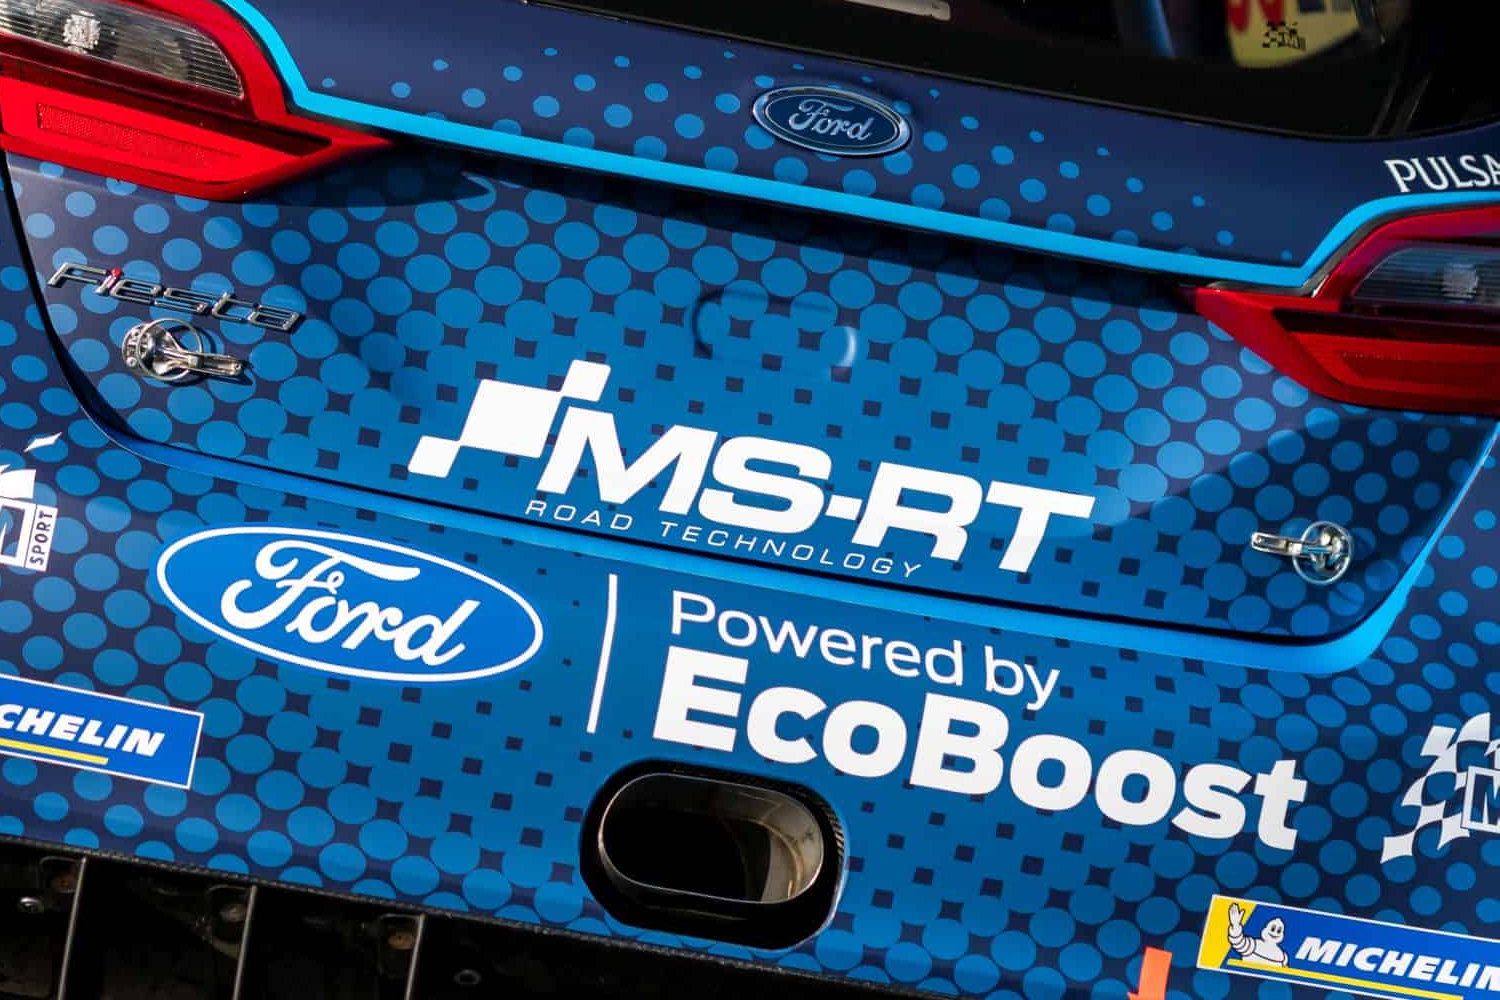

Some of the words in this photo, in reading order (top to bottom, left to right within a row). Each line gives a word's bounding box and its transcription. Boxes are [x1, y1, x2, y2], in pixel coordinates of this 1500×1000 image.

[788, 99, 874, 141] Ford
[48, 262, 299, 331] Fiesta
[30, 510, 53, 566] SPORT
[525, 500, 633, 530] ROAD
[660, 521, 921, 577] TECHNOLOGY
[536, 405, 1096, 573] MS-RT
[220, 539, 480, 666] Ford
[671, 590, 963, 686] Powered
[984, 646, 1060, 711] by
[652, 645, 1308, 851] EcoBoost
